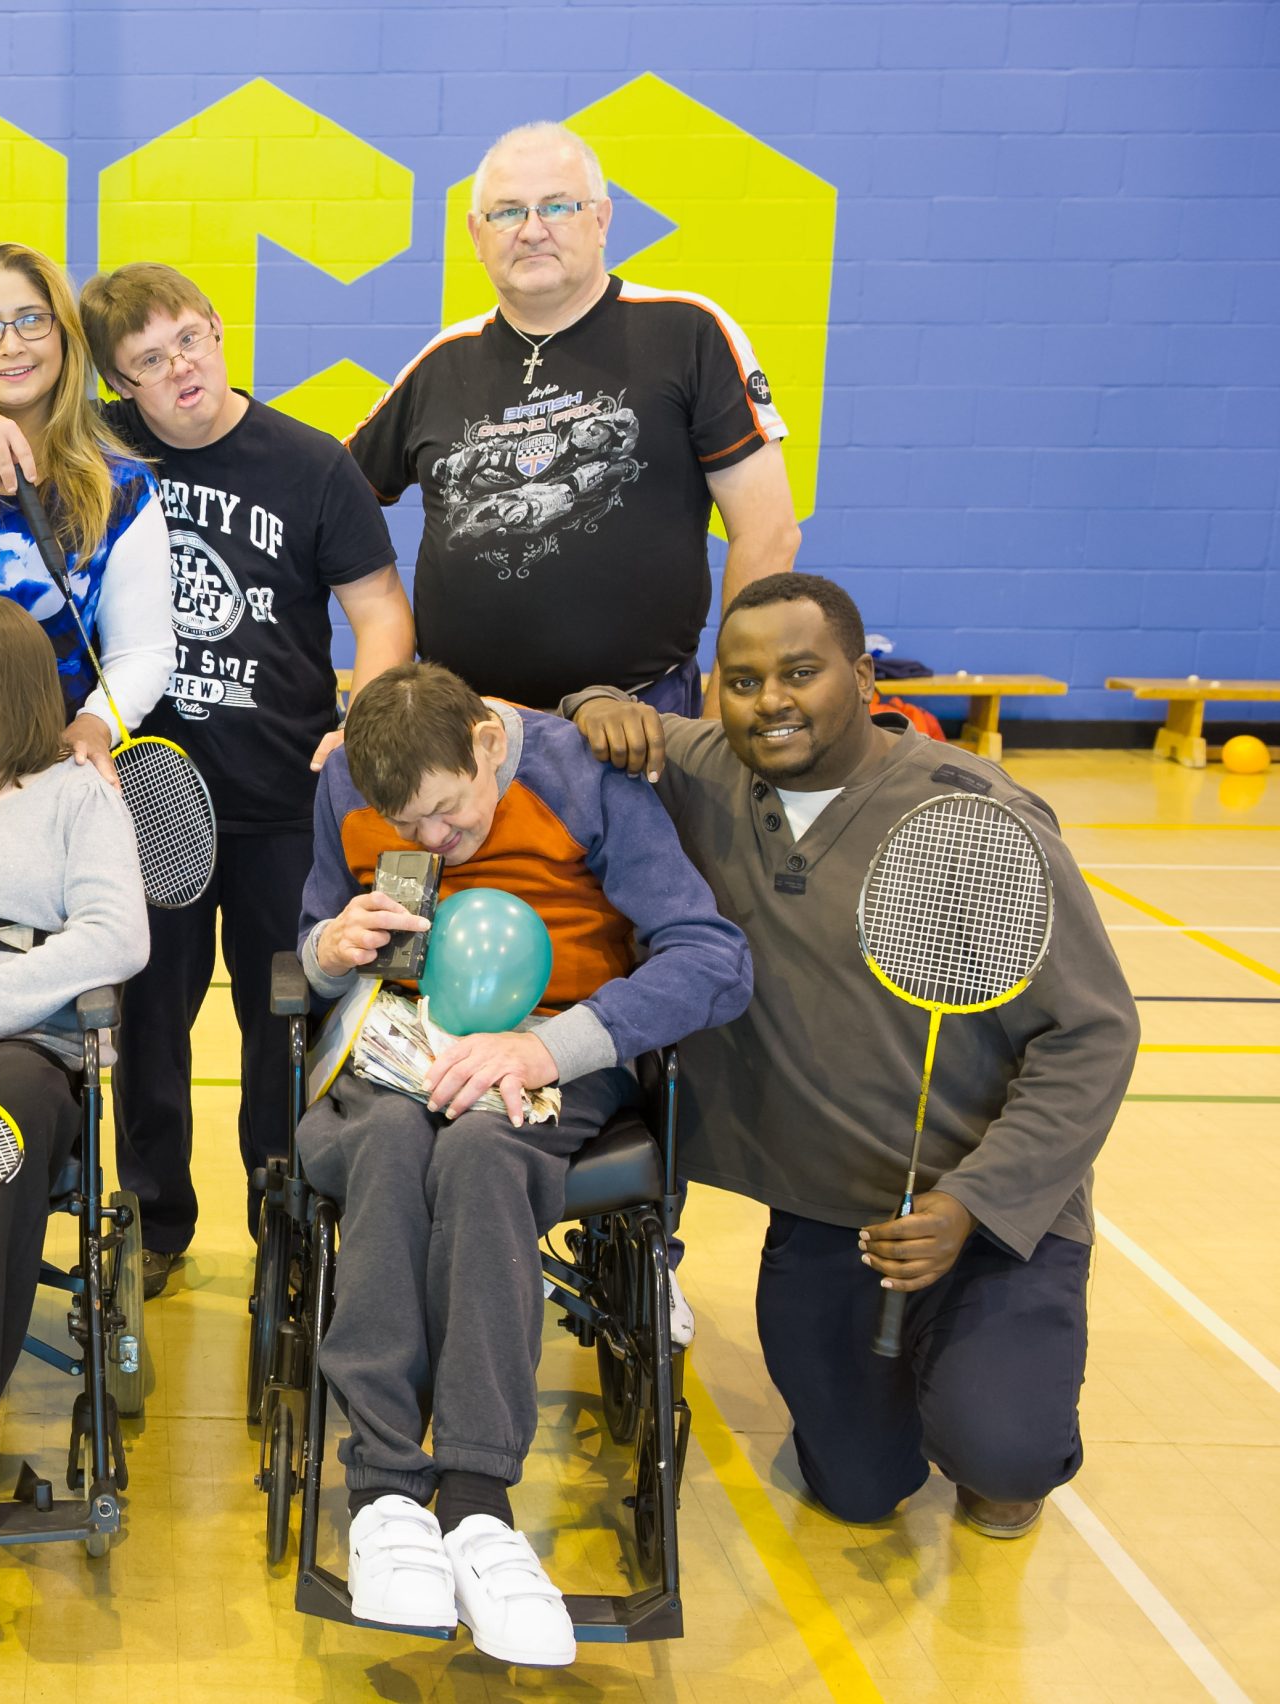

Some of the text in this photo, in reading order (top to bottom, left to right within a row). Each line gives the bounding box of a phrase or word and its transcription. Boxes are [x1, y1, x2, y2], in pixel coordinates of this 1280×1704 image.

[477, 401, 603, 437] GRAND PRIX
[503, 391, 583, 421] BRITISH
[249, 504, 284, 559] OF
[200, 649, 259, 684] SIDE
